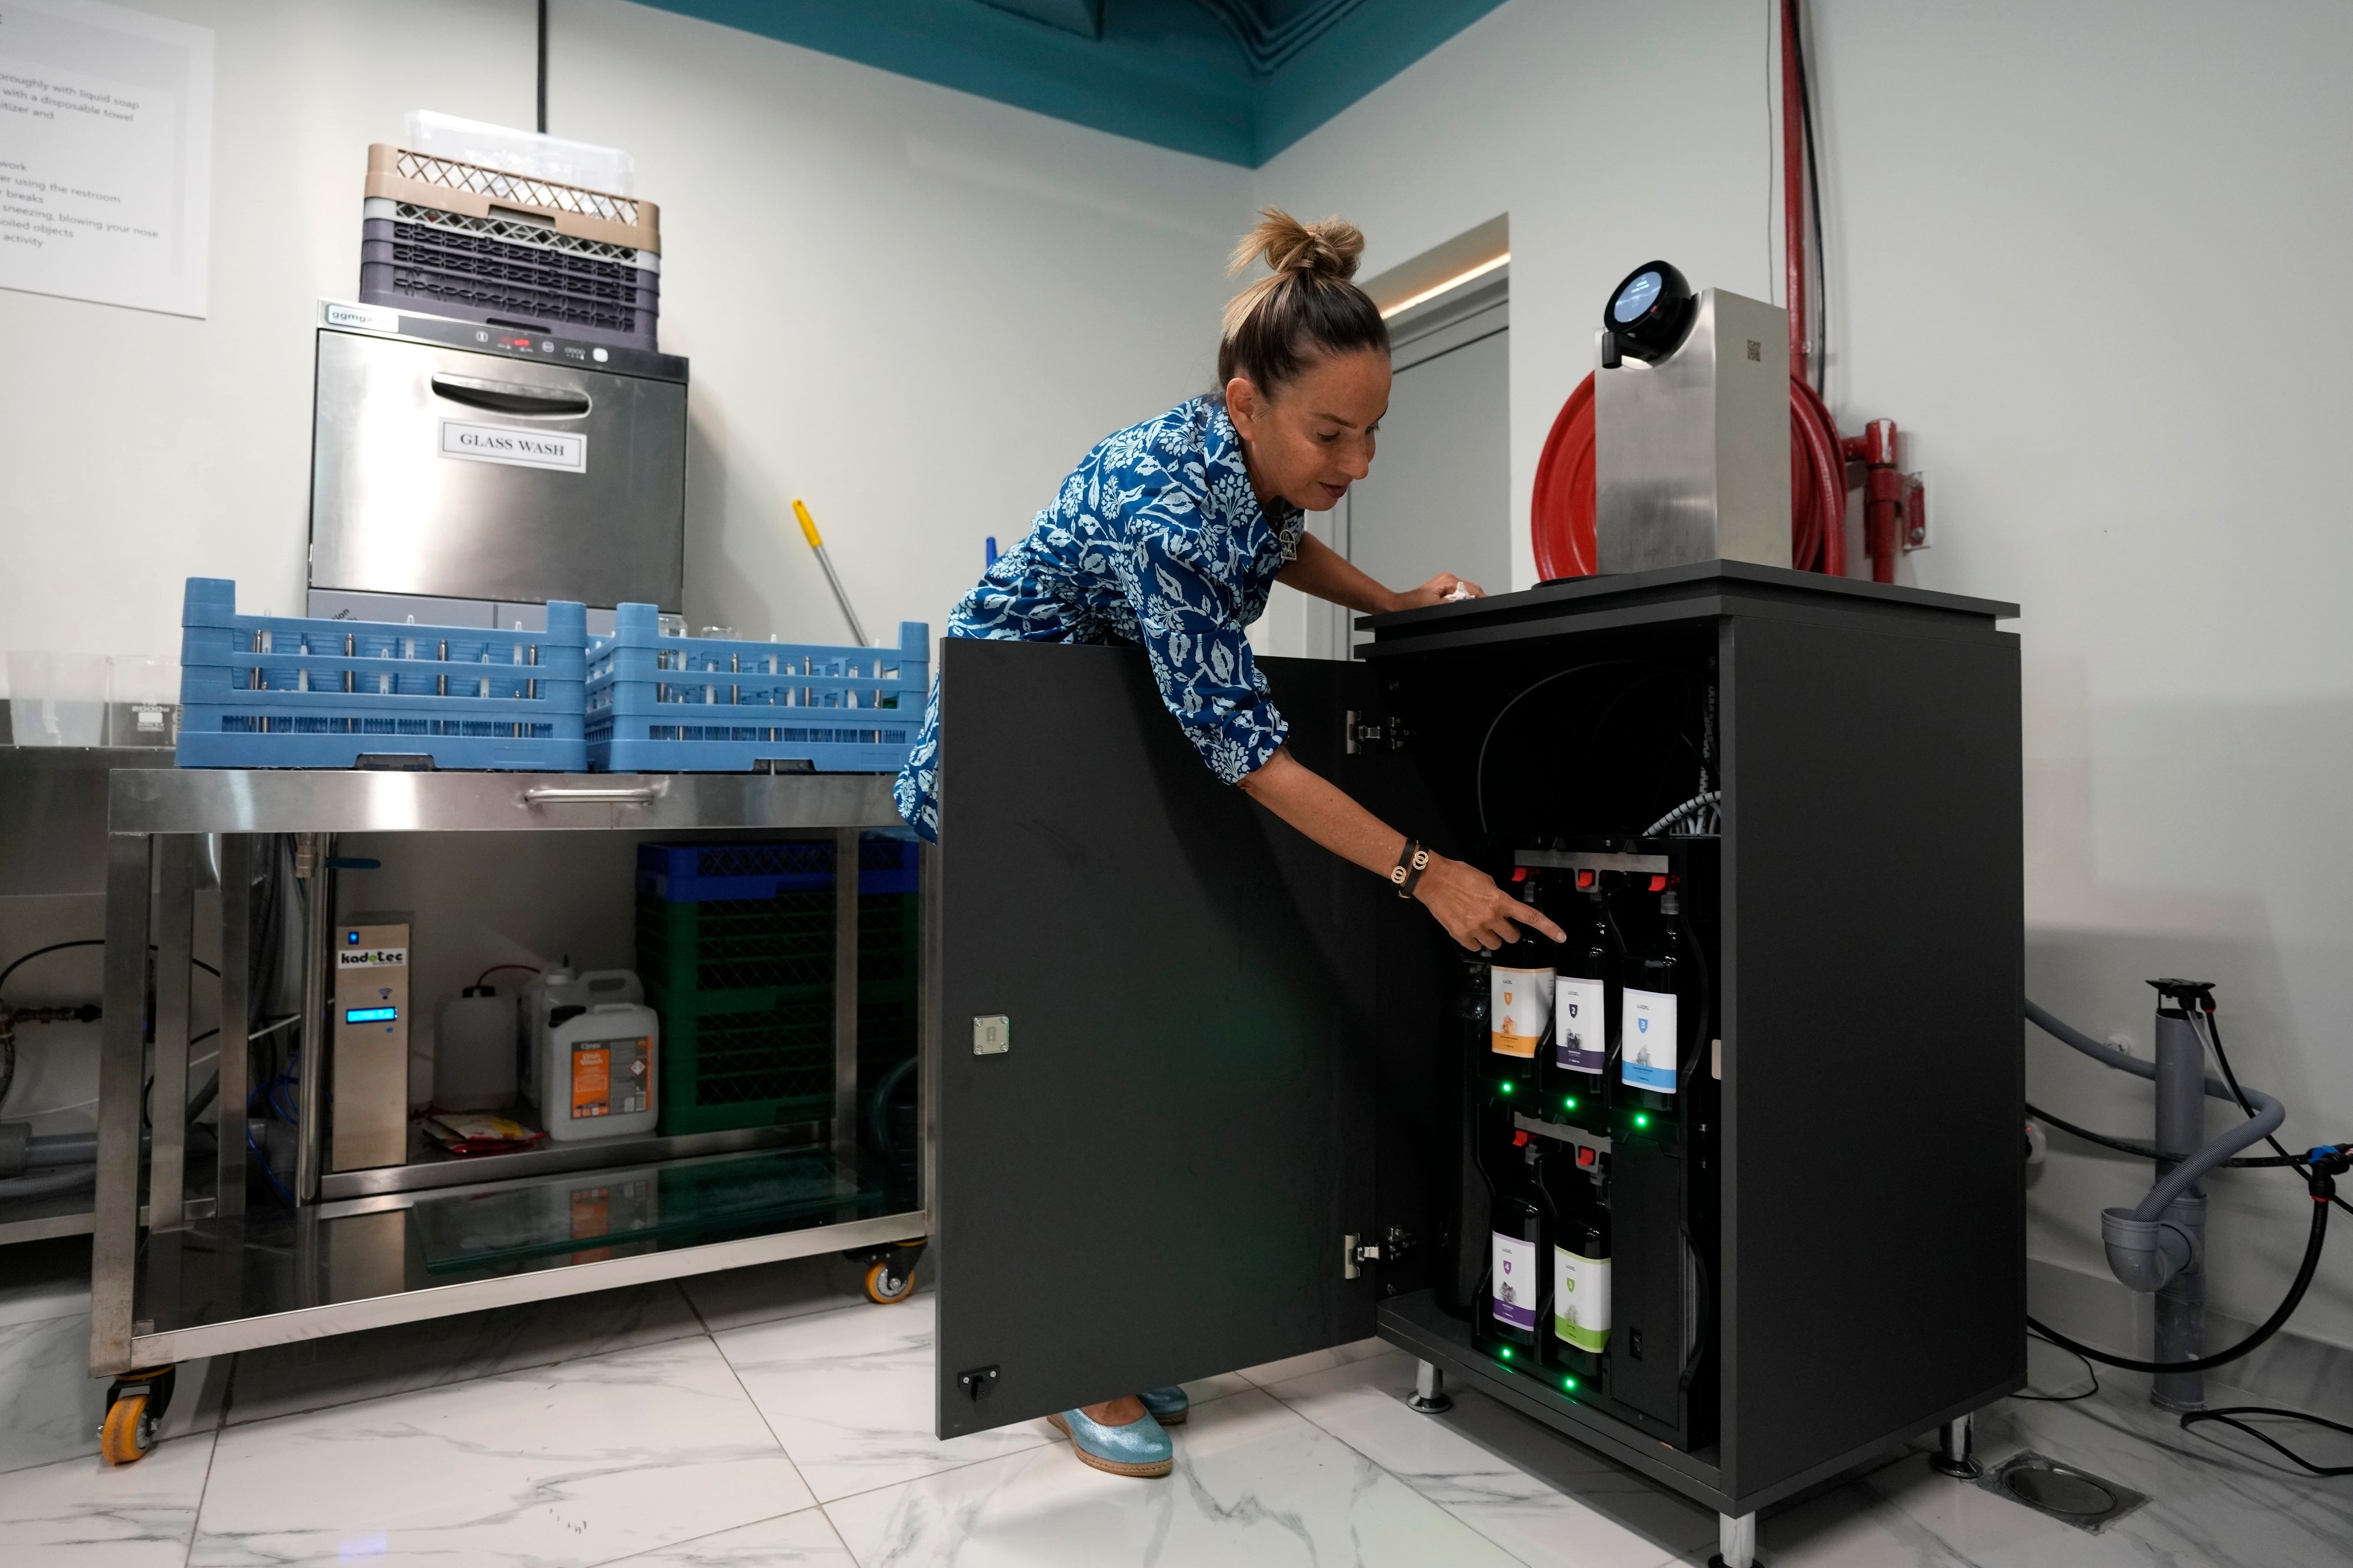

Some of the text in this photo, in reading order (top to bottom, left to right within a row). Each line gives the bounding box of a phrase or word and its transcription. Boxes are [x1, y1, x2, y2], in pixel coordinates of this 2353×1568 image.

[4, 89, 28, 99] with
[41, 96, 101, 115] disposable
[104, 110, 134, 121] towel
[52, 85, 76, 95] with
[79, 89, 110, 103] liquid
[114, 98, 139, 110] soap
[33, 110, 54, 119] and
[6, 188, 44, 203] breaks
[15, 178, 46, 192] using
[50, 184, 67, 193] the
[71, 188, 121, 203] restroom
[0, 219, 74, 238] oiled objects
[59, 213, 103, 230] blowing
[106, 223, 129, 233] your
[134, 228, 159, 238] nose
[3, 233, 44, 249] activity
[461, 433, 564, 456] GLASS WASH
[341, 951, 404, 963] kadotec
